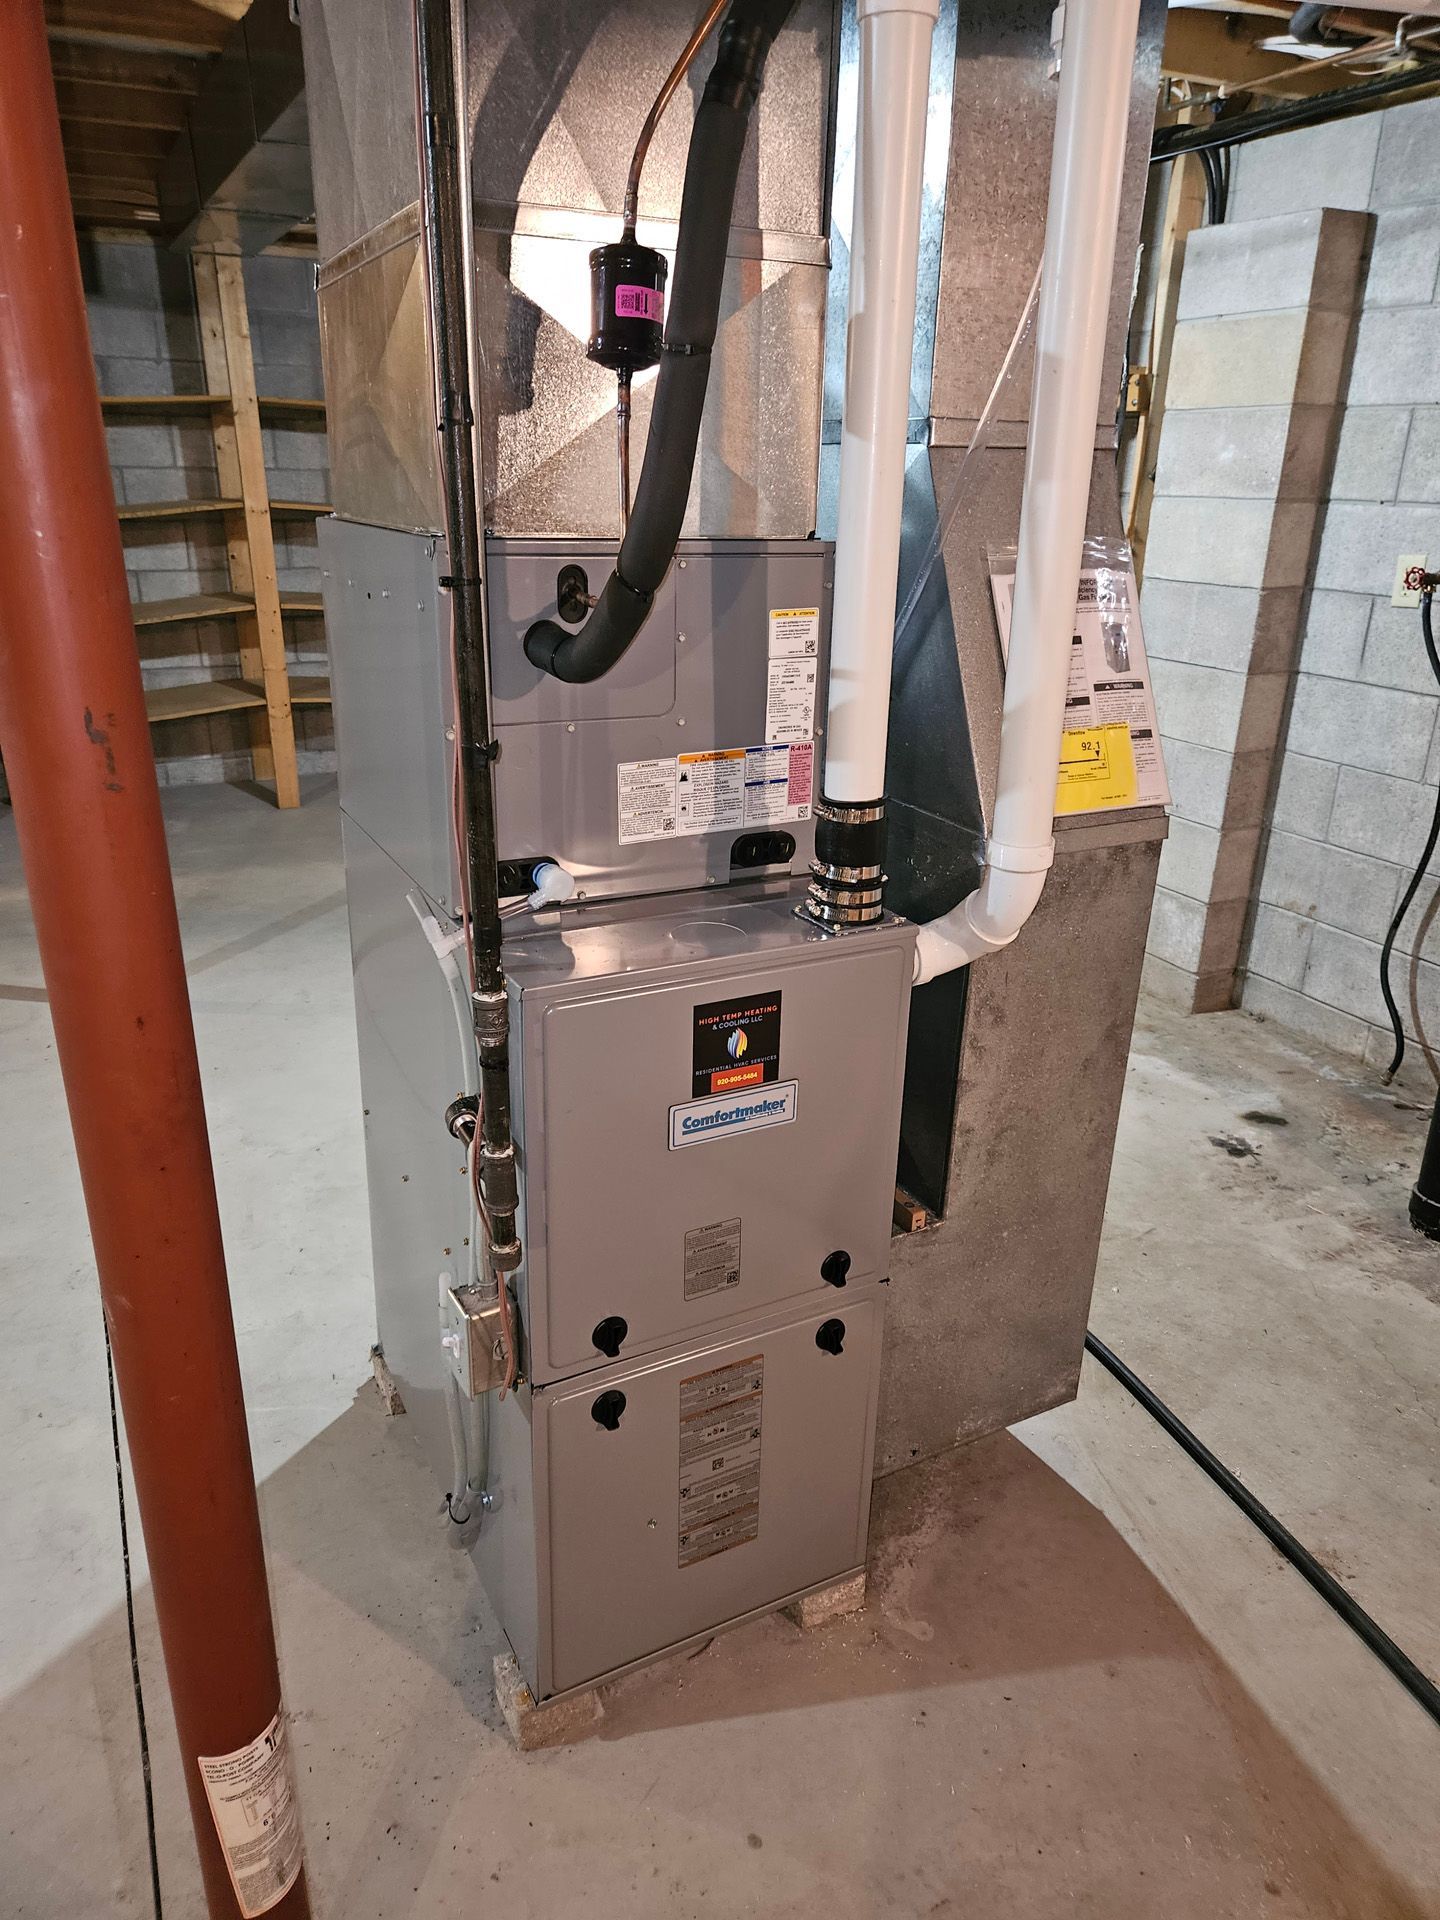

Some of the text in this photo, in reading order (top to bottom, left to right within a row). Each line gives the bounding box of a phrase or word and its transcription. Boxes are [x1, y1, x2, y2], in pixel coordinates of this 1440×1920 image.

[790, 744, 812, 752] R-410A
[1081, 741, 1100, 751] 92.1
[698, 1004, 778, 1026] HIGH TEMP HEATING
[718, 1017, 750, 1029] COOLING
[751, 1015, 763, 1023] LLC
[695, 1054, 777, 1077] RESIDENTIAL HVAC SERVICES
[682, 1099, 786, 1130] Comfortmaker
